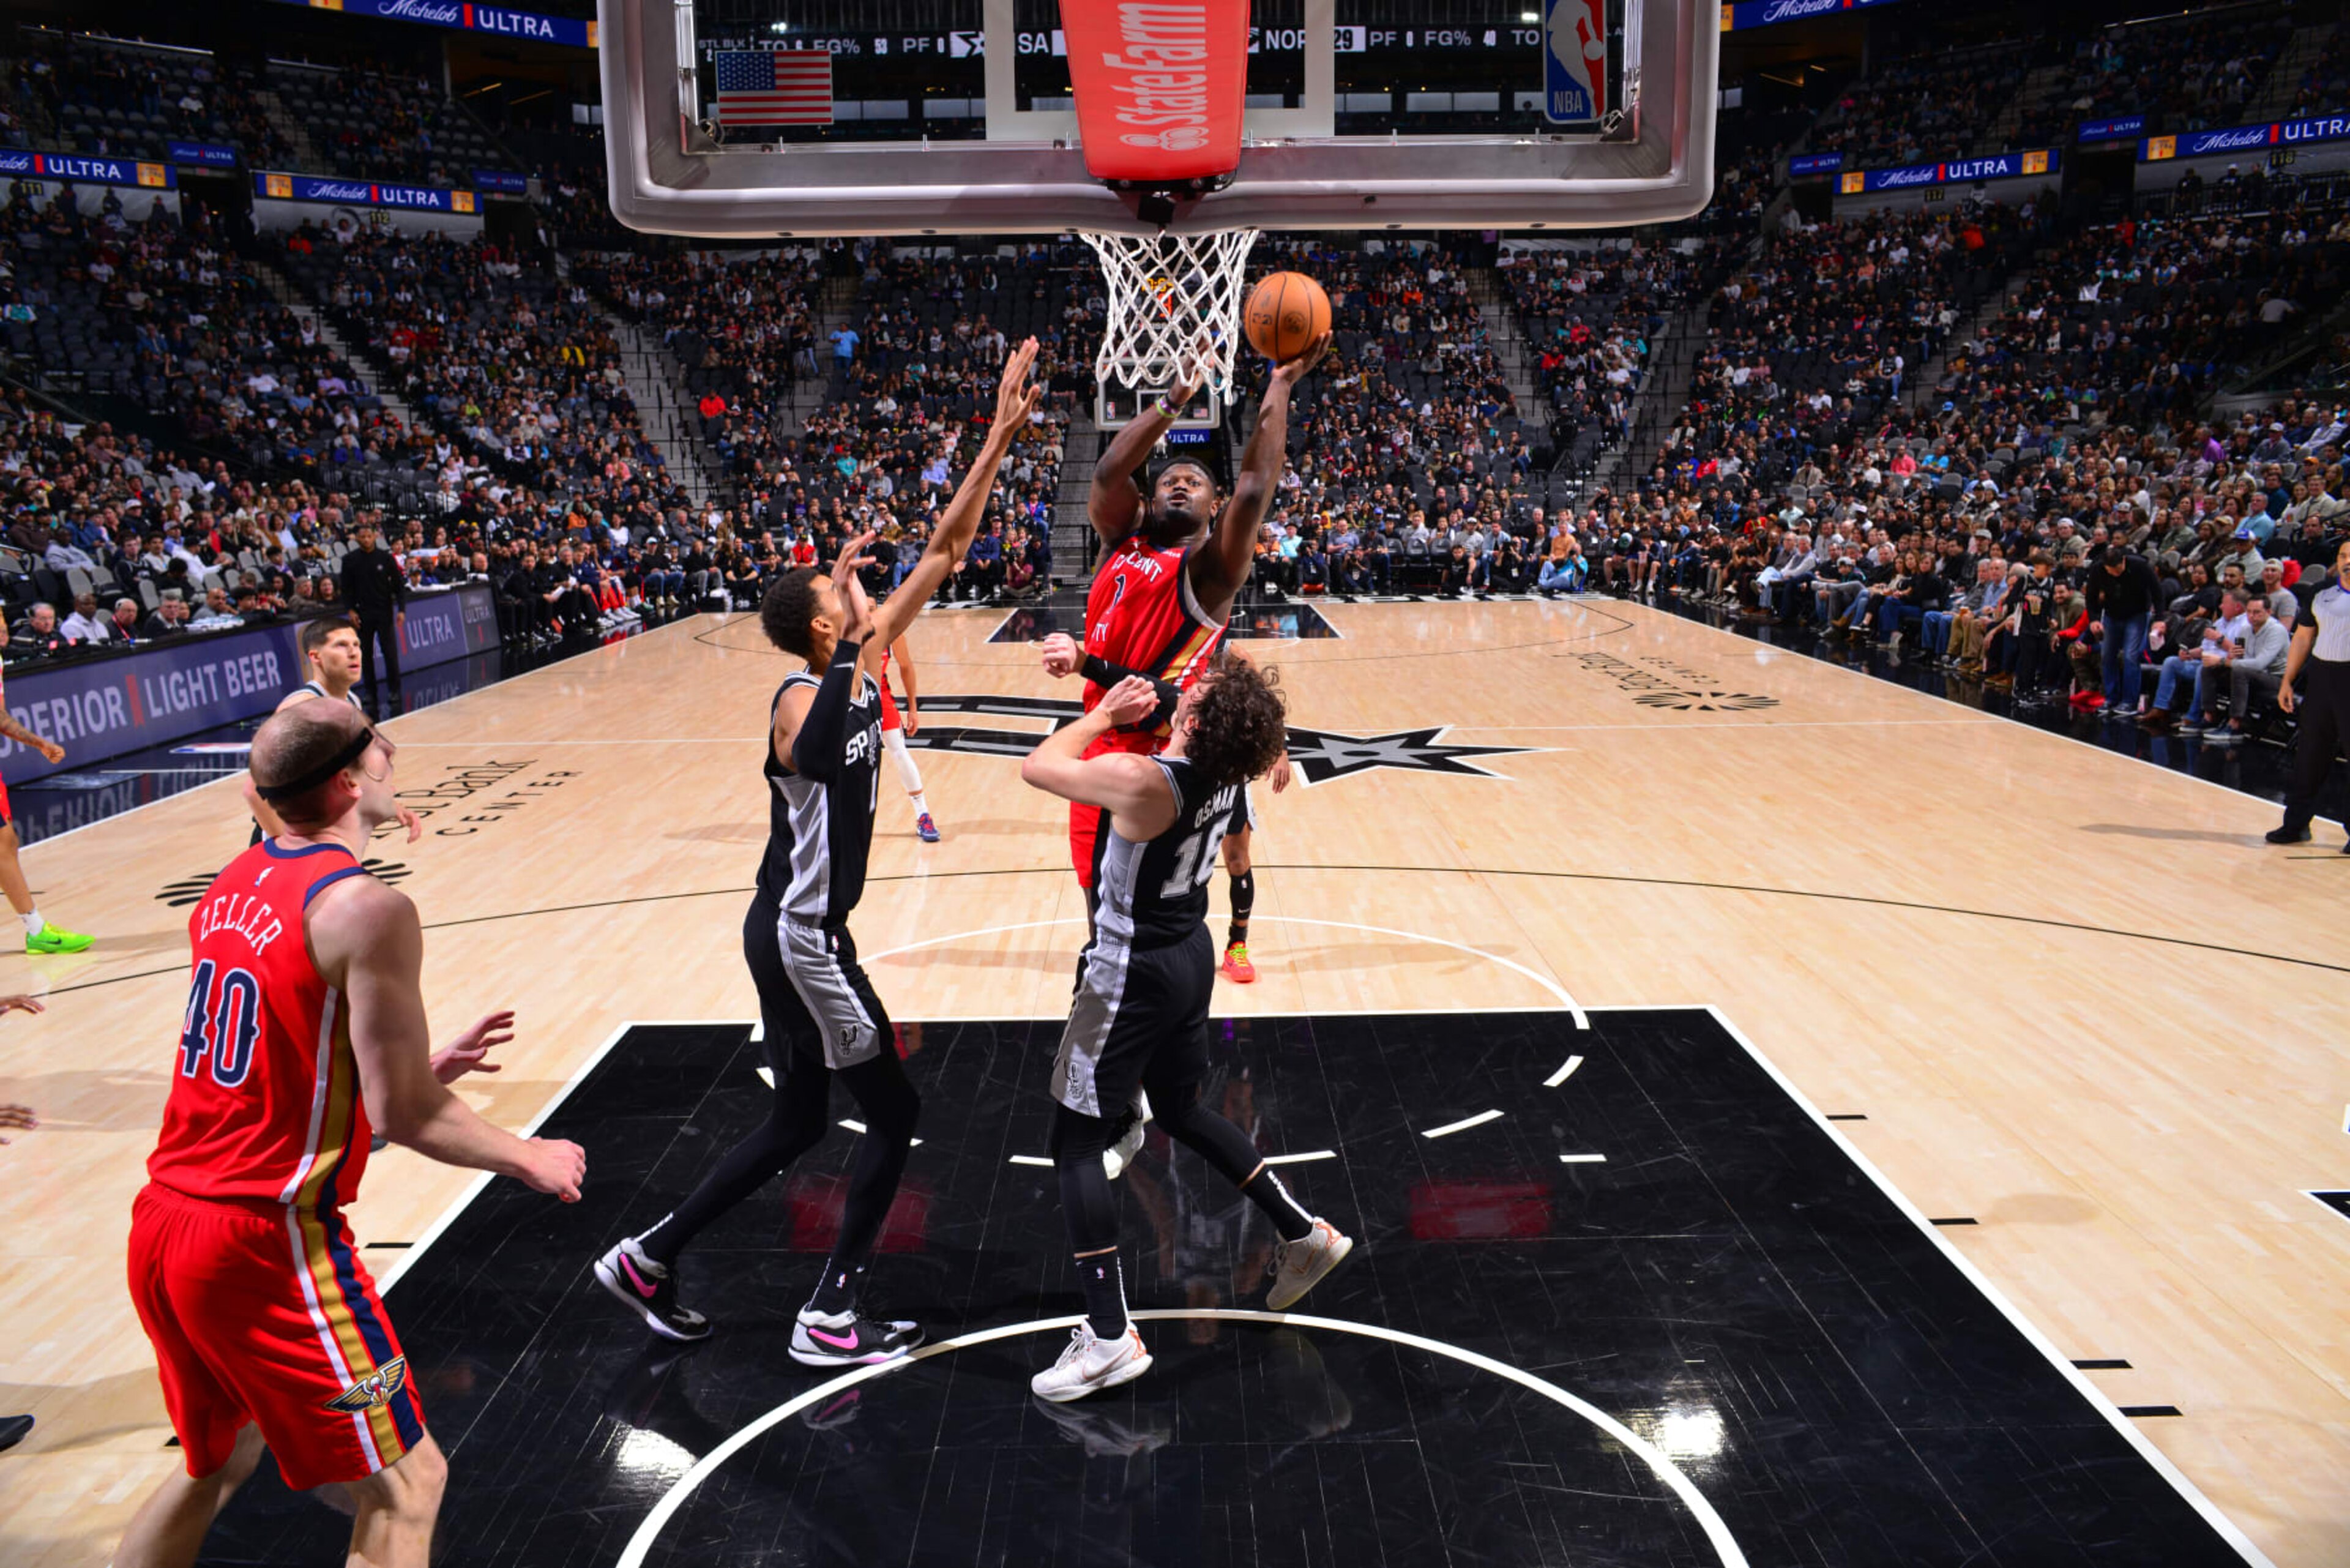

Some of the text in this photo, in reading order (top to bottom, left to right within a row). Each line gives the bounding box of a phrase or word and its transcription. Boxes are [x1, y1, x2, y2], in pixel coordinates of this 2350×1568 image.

[378, 0, 554, 38] Michelob ULTRA
[903, 37, 930, 53] PF
[1017, 32, 1049, 54] SA
[1370, 32, 1397, 47] PF
[1424, 30, 1472, 47] FG%
[1510, 29, 1541, 47] TO
[1553, 91, 1583, 113] NBA
[2193, 127, 2266, 152] Michelob
[49, 158, 123, 179] ULTRA
[1877, 166, 1931, 187] Michelob
[1949, 159, 2009, 179] ULTRA
[307, 183, 368, 201] Michelob
[381, 189, 441, 207] ULTRA
[1106, 574, 1126, 614] 1
[406, 613, 455, 649] ULTRA
[144, 662, 220, 719] LIGHT
[223, 649, 282, 698] BEER
[435, 771, 584, 837] CENTER
[1194, 783, 1238, 829] OSMAN
[1160, 810, 1234, 899] 16
[200, 893, 283, 957] ZELLER
[180, 958, 261, 1088] 40
